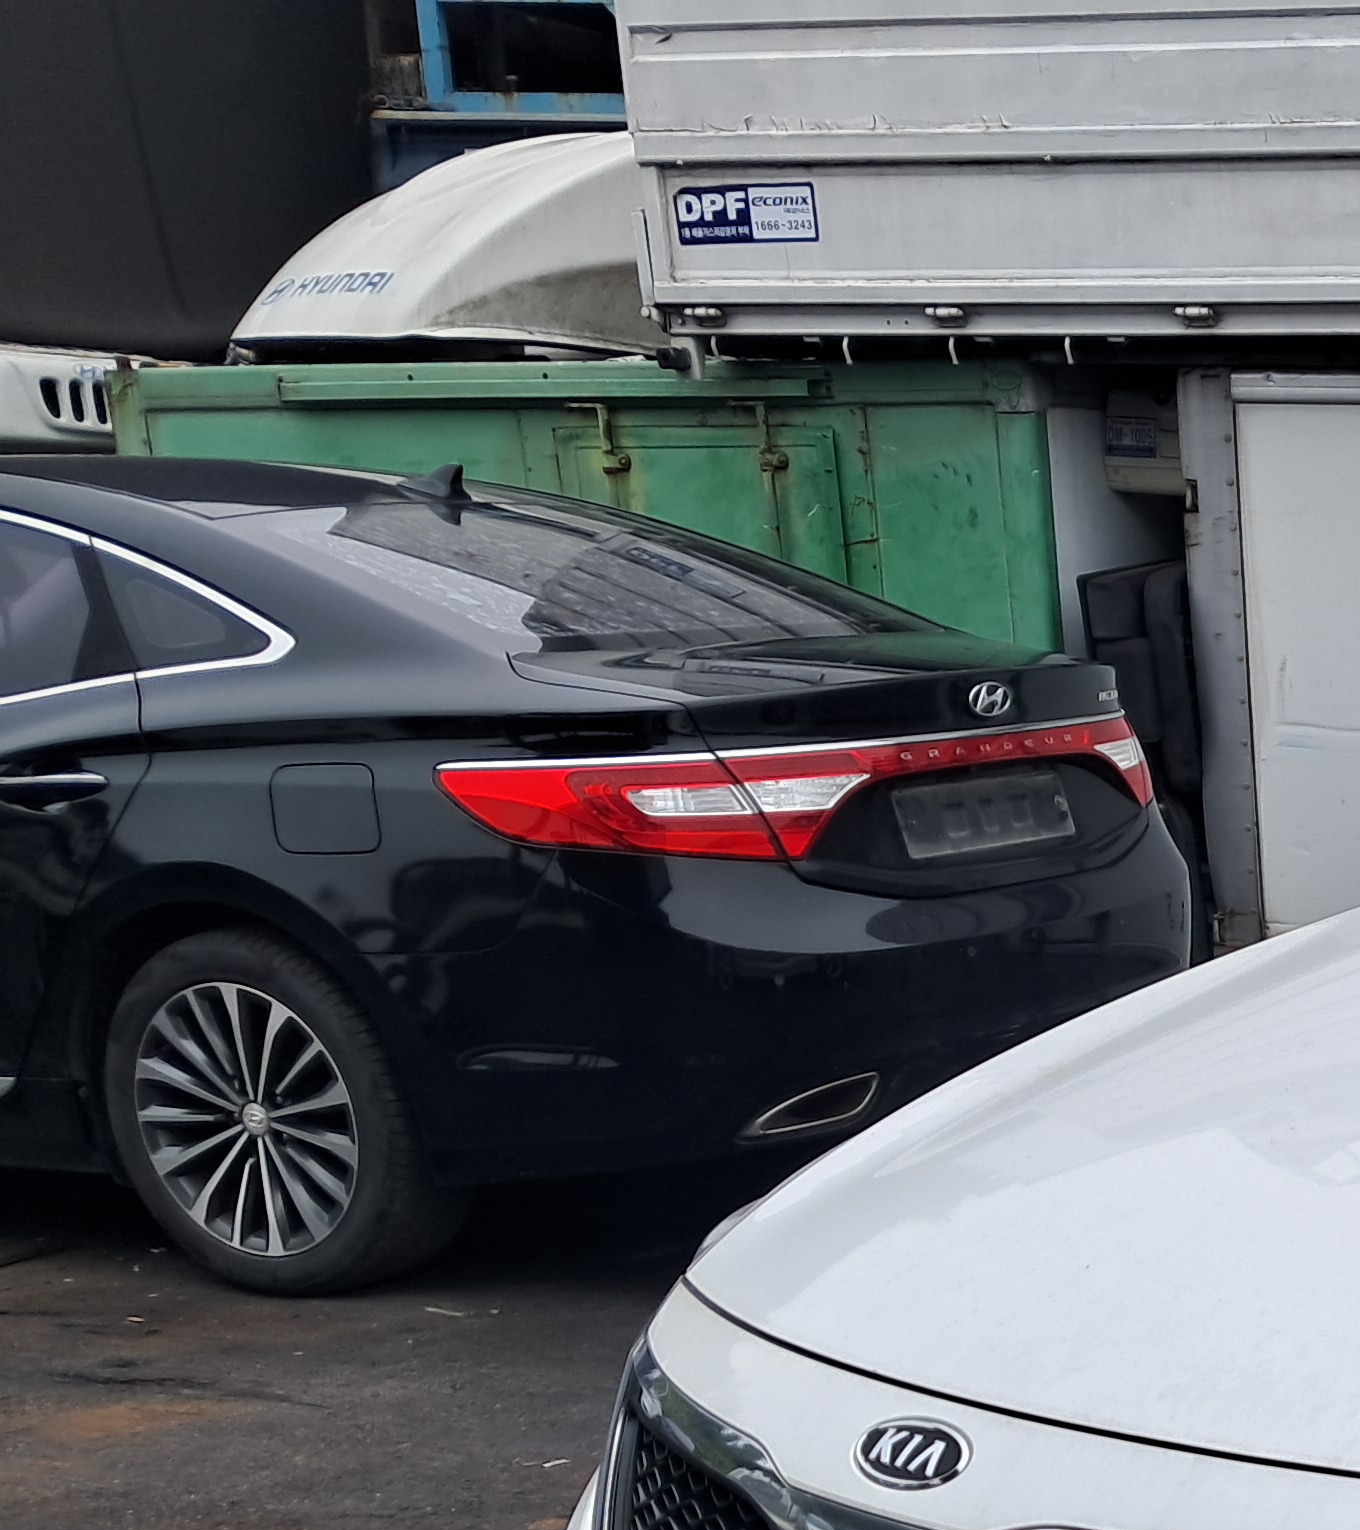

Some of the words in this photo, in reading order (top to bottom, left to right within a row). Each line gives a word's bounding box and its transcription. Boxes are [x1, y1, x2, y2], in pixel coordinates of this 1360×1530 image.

[676, 191, 746, 222] DPF
[751, 195, 809, 207] econix
[755, 219, 813, 232] 1666-3243
[290, 271, 395, 297] HYUNDAI
[900, 733, 1073, 761] GRANDEUR
[867, 1427, 947, 1478] KIA
